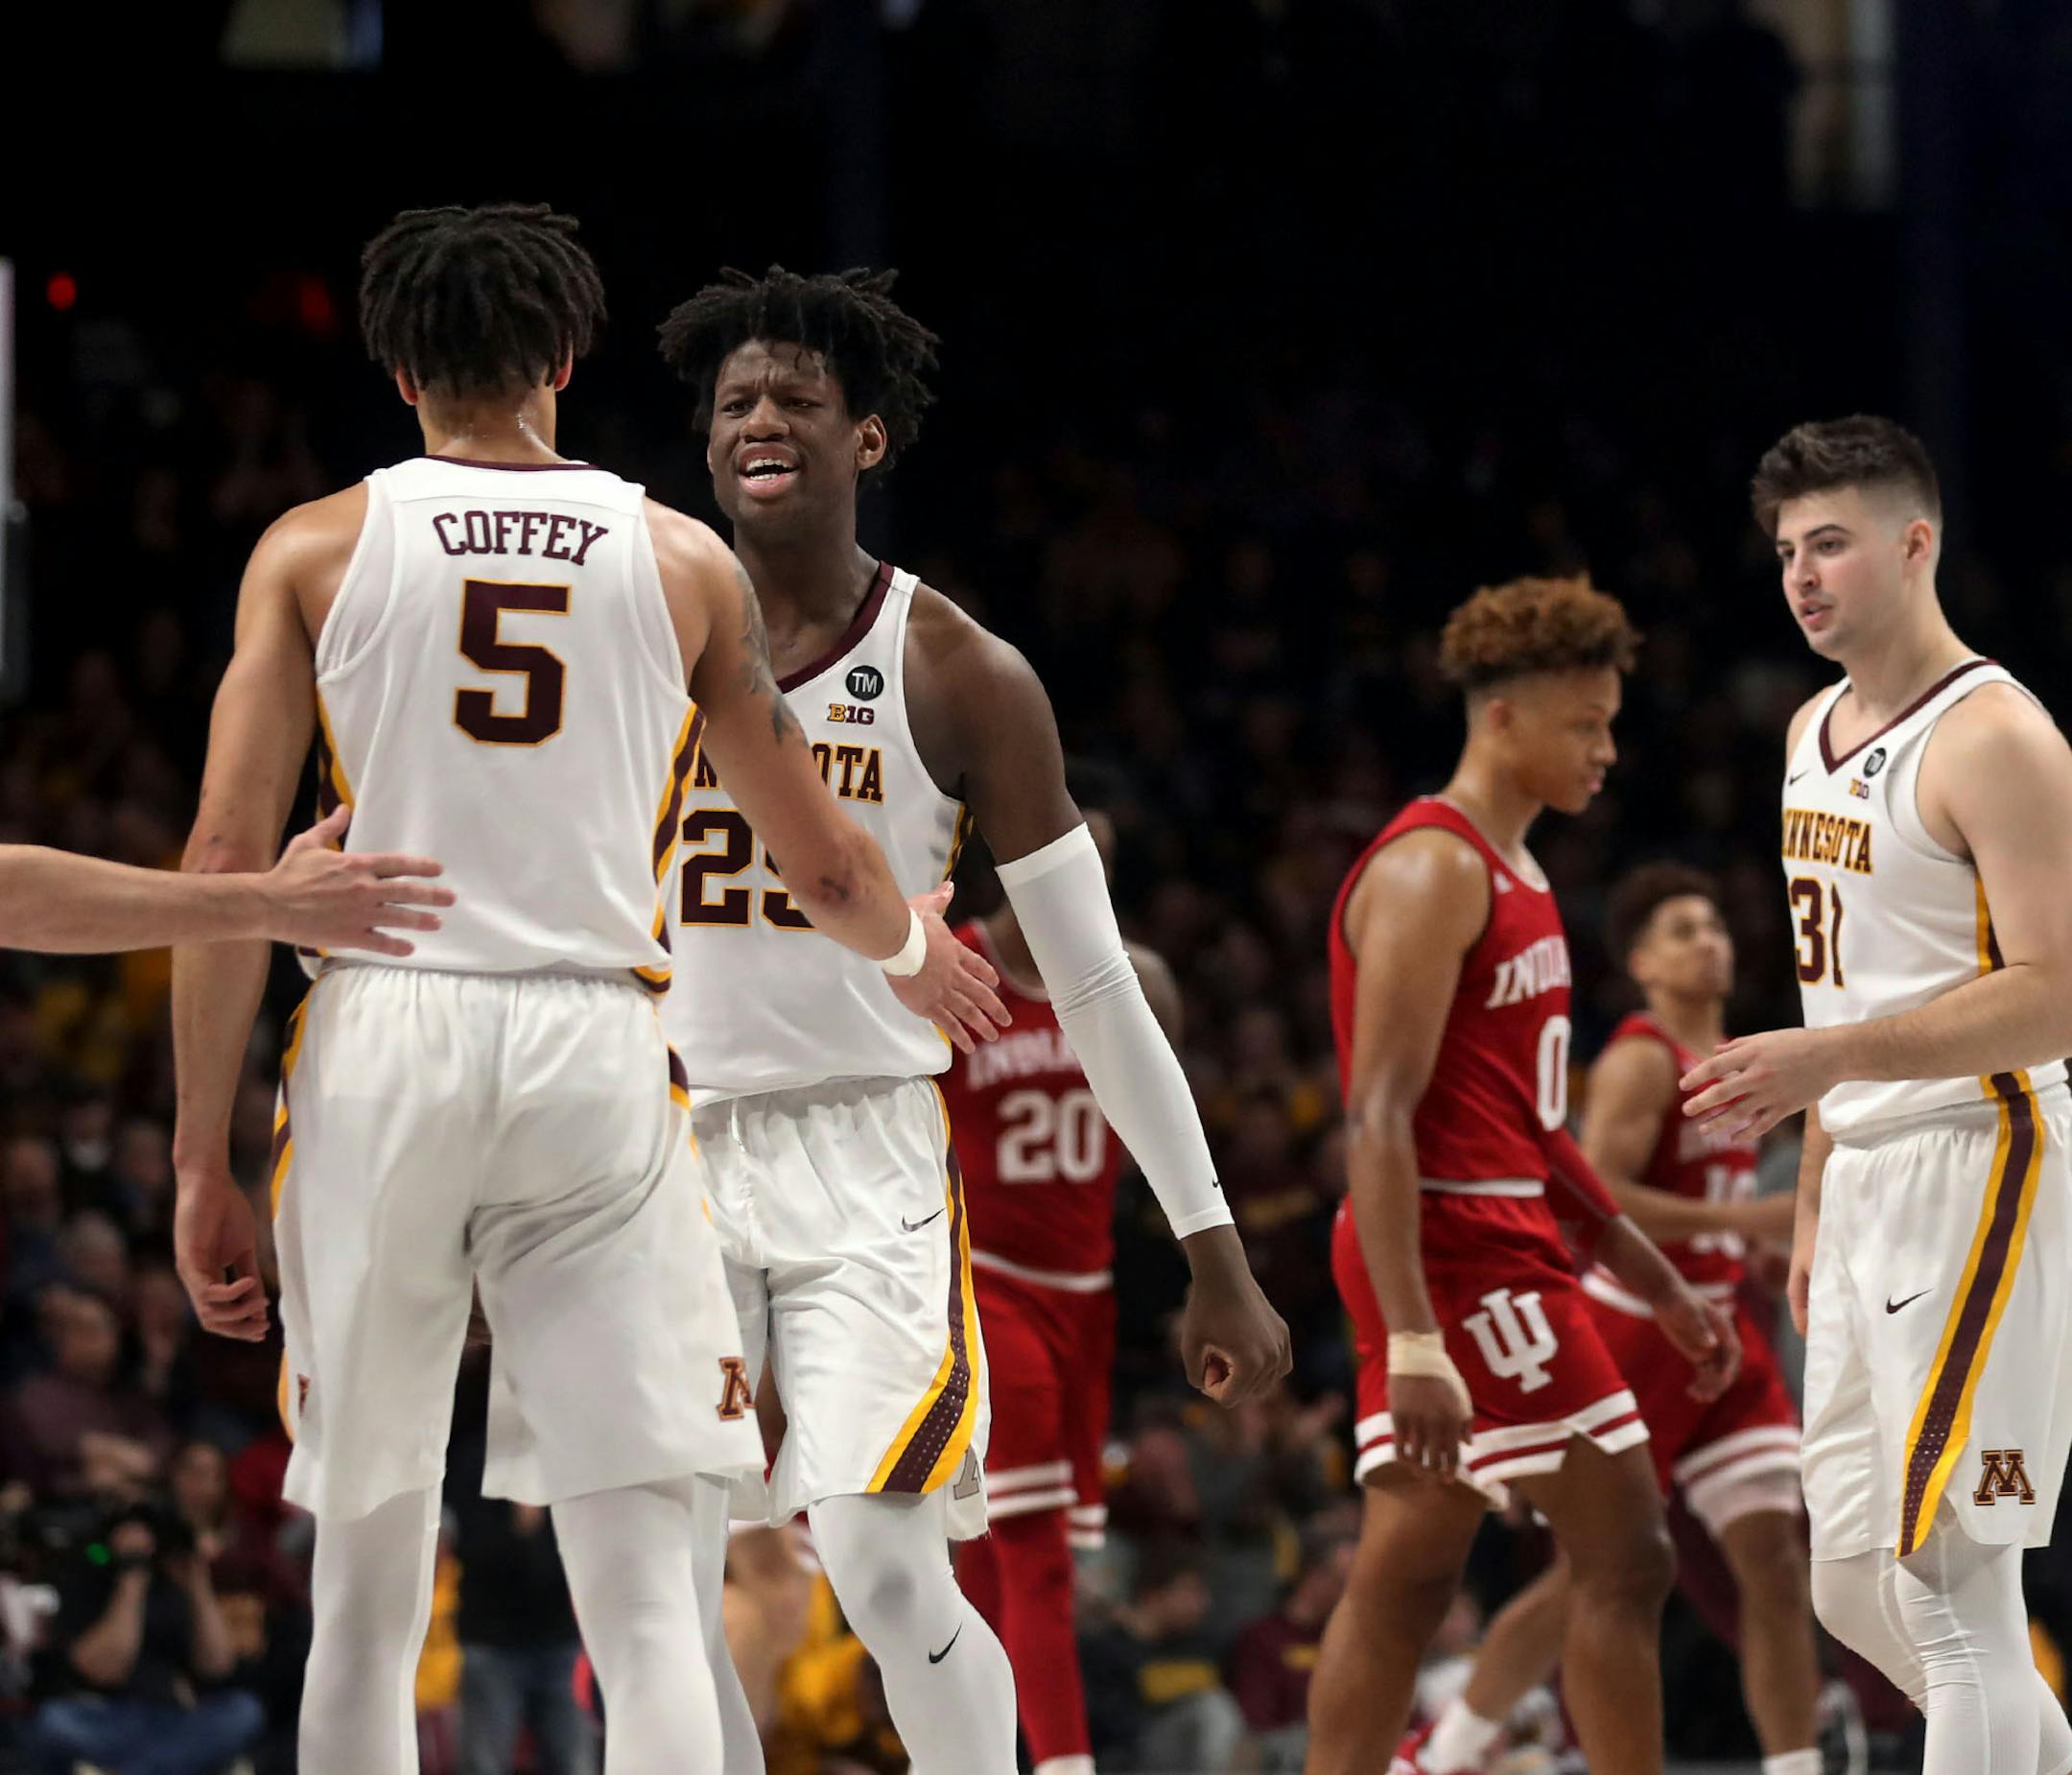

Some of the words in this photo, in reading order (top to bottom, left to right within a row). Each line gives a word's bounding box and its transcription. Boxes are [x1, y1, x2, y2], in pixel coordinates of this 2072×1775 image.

[433, 509, 609, 566] COFFEY
[453, 579, 572, 748] 5
[852, 672, 878, 695] TM
[1538, 1014, 1572, 1132] 0
[995, 1086, 1107, 1184] 20
[1973, 1449, 2037, 1505] M
